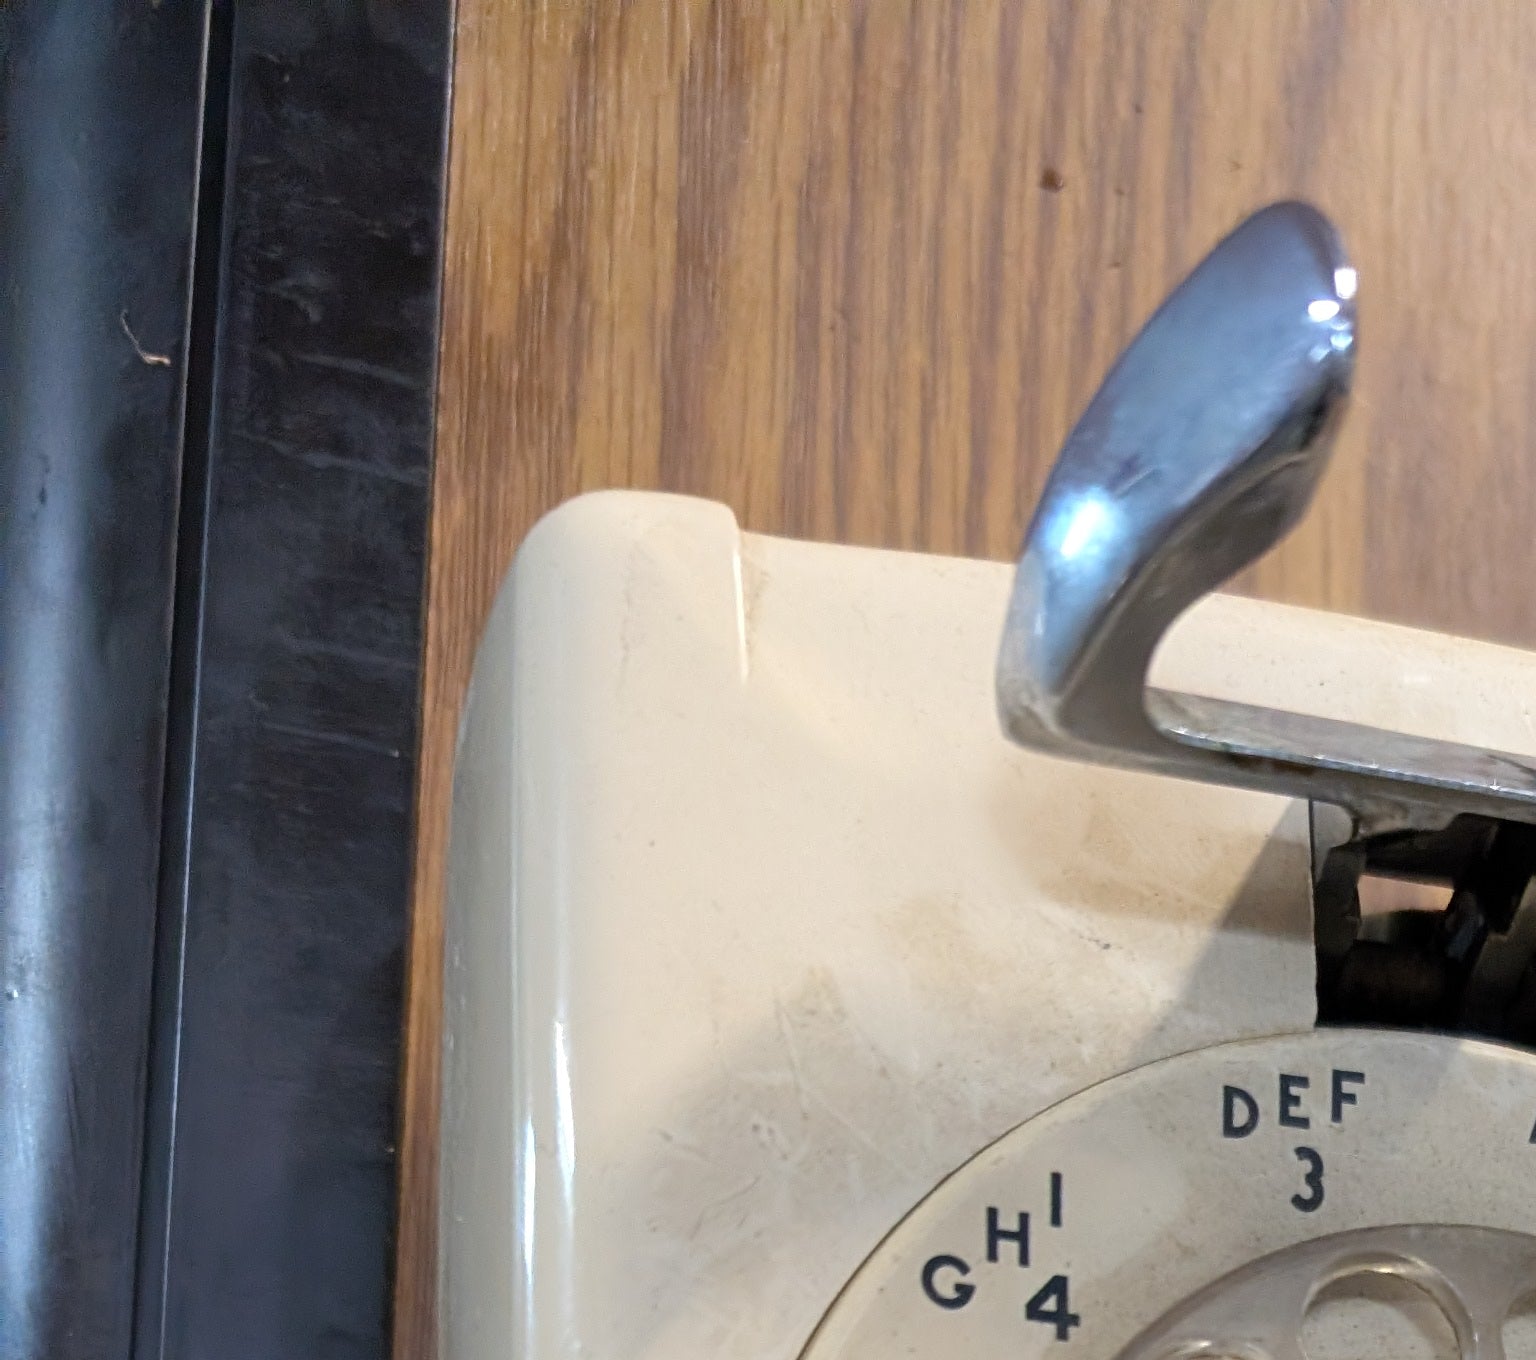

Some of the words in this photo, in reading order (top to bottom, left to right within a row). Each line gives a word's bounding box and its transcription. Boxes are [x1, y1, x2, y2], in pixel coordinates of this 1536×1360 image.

[1222, 1069, 1365, 1138] DEF
[1291, 1146, 1324, 1213] 3
[1025, 1274, 1080, 1342] 4
